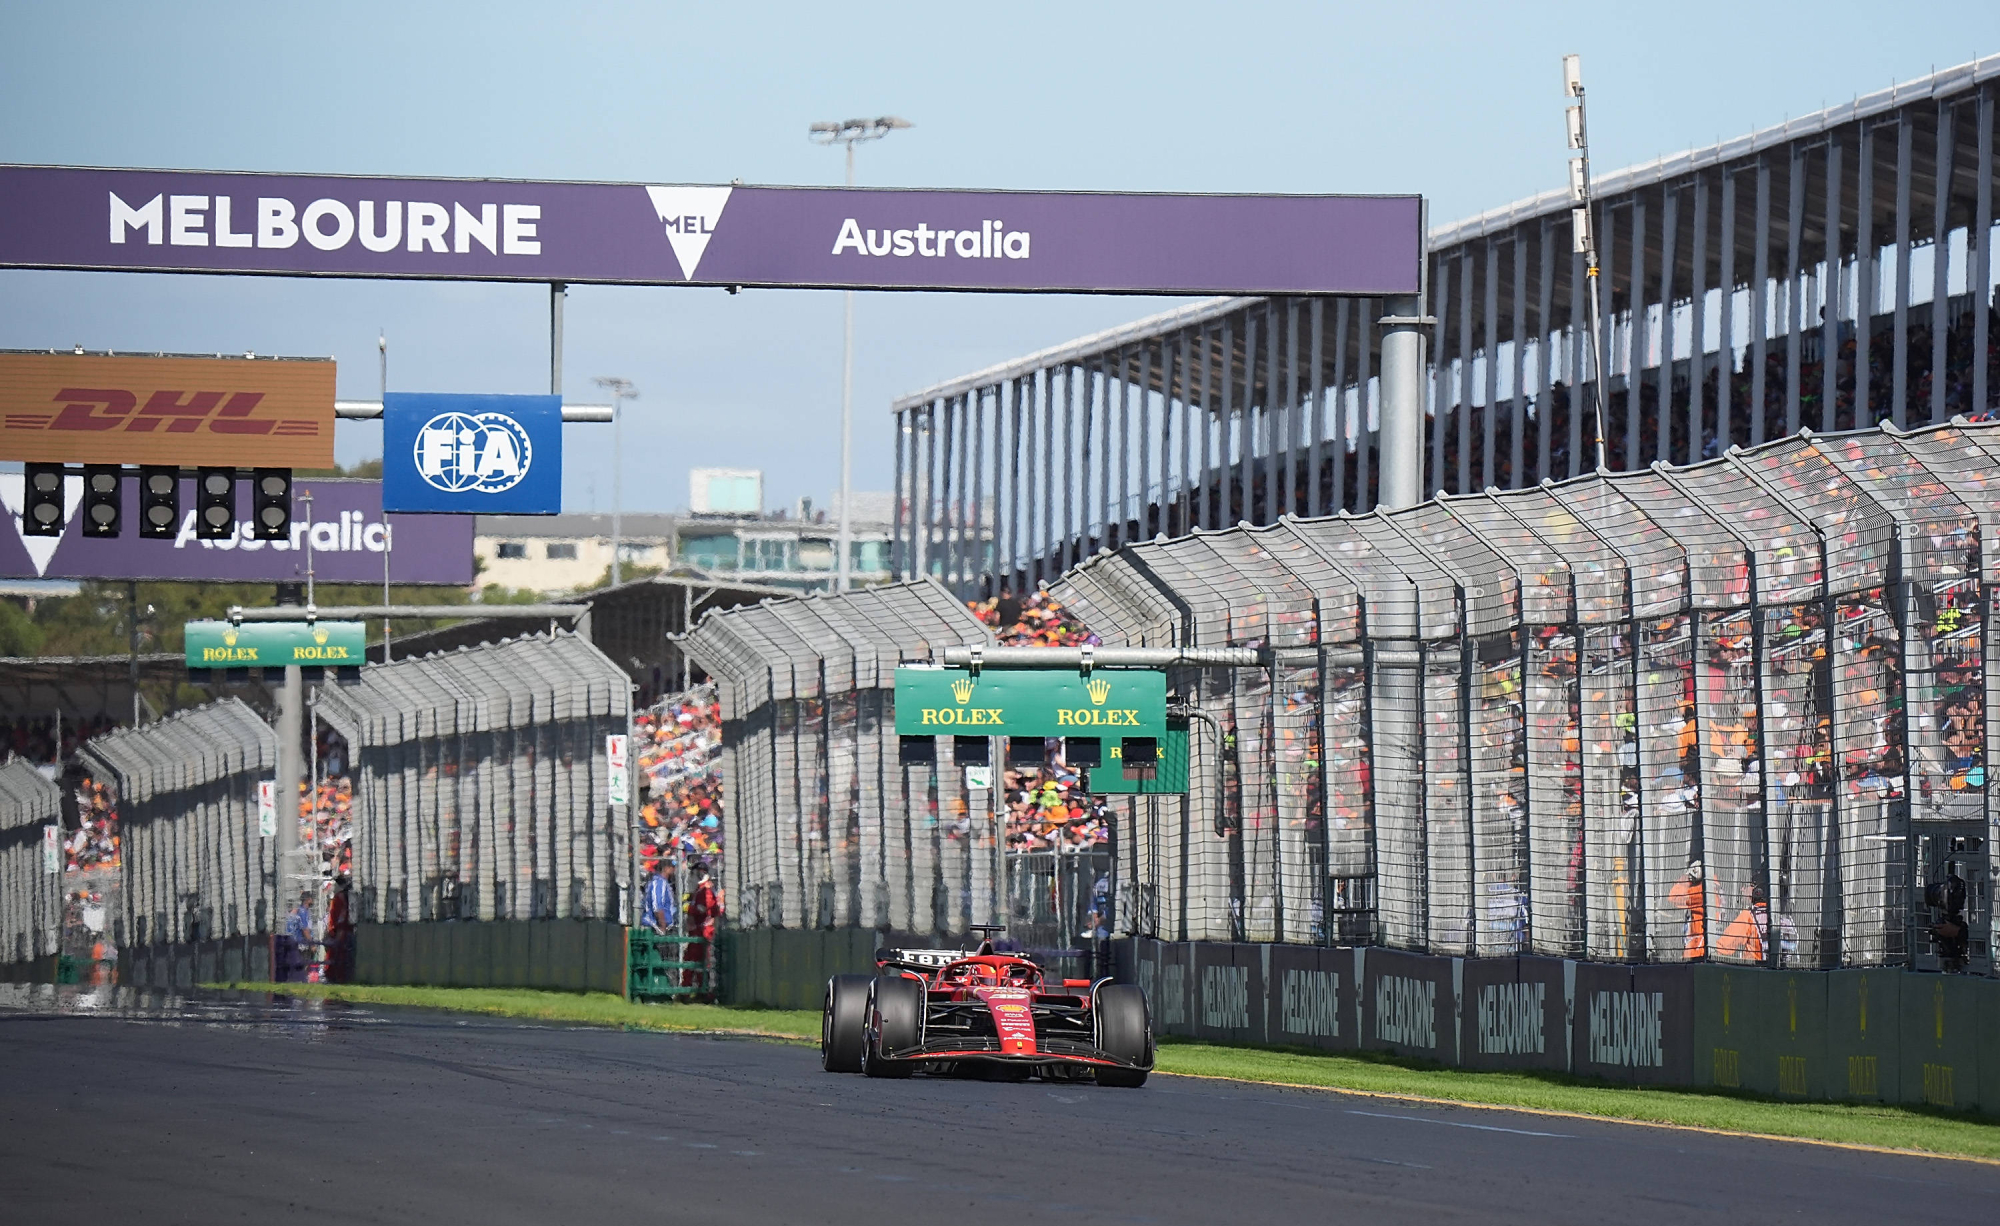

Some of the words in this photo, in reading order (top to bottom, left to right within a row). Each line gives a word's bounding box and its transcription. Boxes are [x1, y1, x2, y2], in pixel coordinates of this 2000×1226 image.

[109, 191, 541, 255] MELBOURNE
[661, 215, 713, 234] MEL
[831, 218, 1030, 259] Australia
[48, 388, 277, 435] DHL
[203, 647, 258, 661] ROLEX
[293, 646, 349, 659] ROLEX
[921, 708, 1004, 725] ROLEX
[1057, 709, 1140, 726] ROLEX
[1282, 969, 1339, 1037] MELBOURNE
[1375, 974, 1436, 1049] MELBOURNE
[1478, 982, 1545, 1055] MELBOURNE
[1589, 990, 1663, 1067] MELBOURNE
